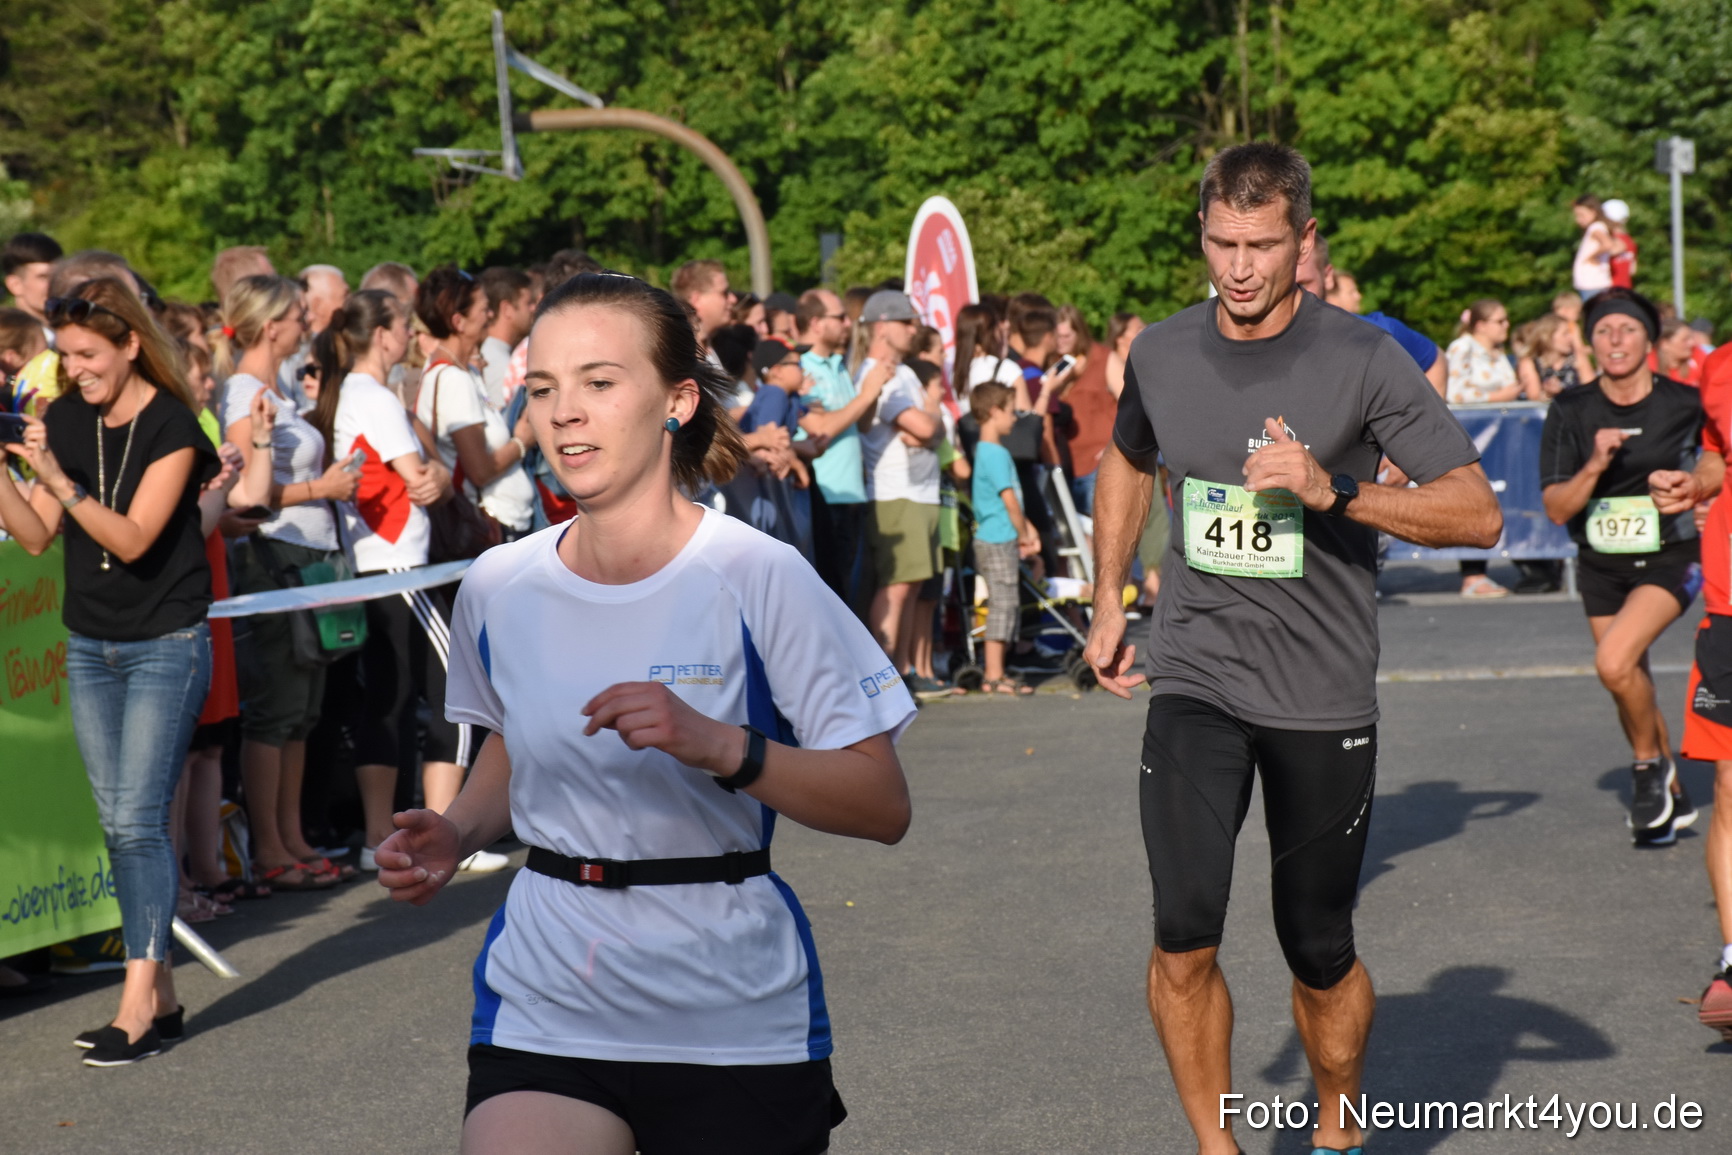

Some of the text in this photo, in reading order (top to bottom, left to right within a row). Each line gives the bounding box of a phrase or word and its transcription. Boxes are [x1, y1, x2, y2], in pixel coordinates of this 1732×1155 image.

[1595, 516, 1647, 537] 1972
[1204, 516, 1272, 552] 418
[1196, 546, 1286, 563] Kainzbauer Thomas
[1212, 559, 1243, 567] Burkhardt
[677, 664, 723, 676] PETTER
[1353, 736, 1369, 746] JAKO
